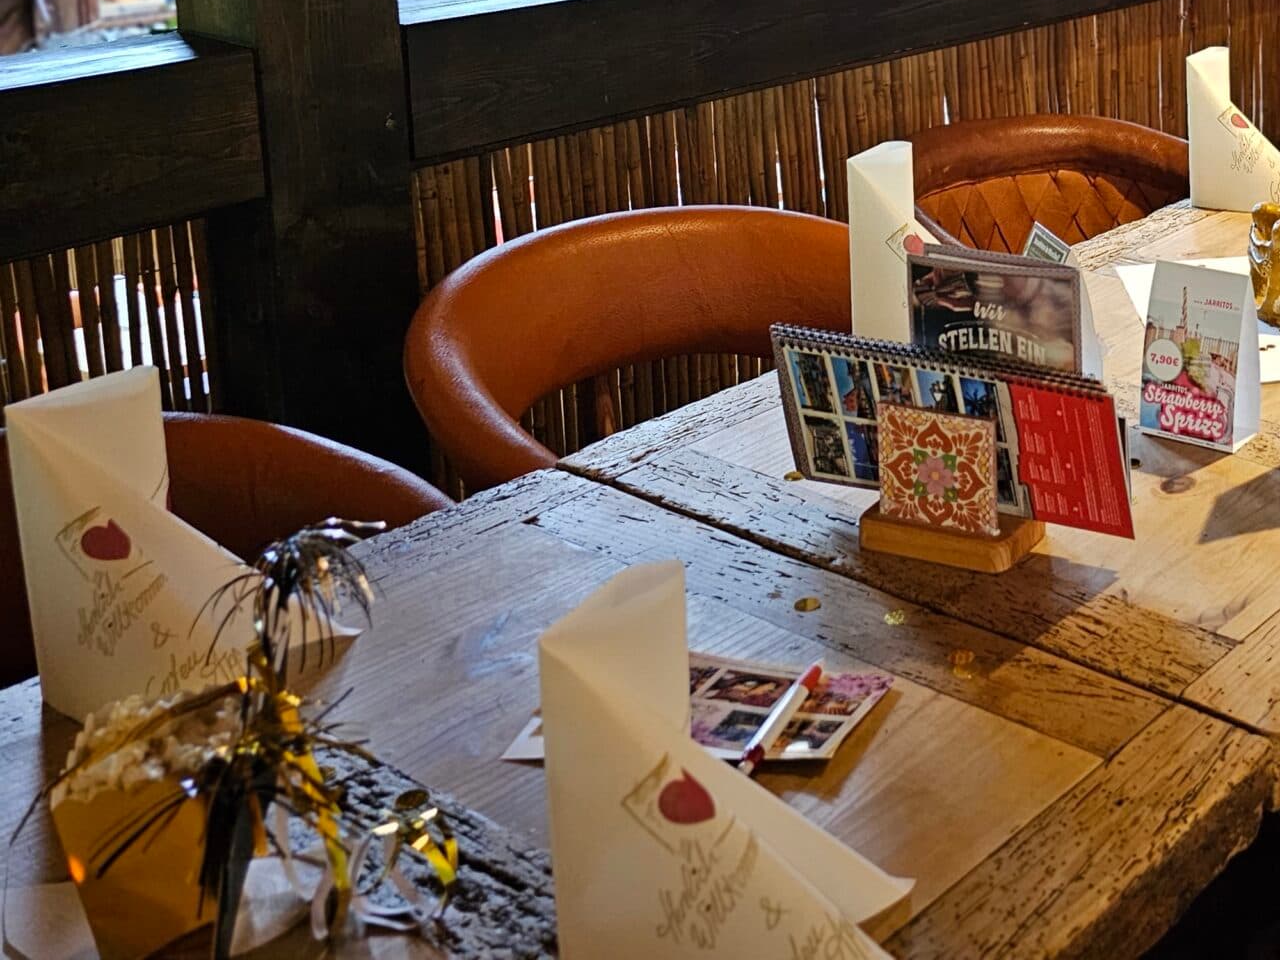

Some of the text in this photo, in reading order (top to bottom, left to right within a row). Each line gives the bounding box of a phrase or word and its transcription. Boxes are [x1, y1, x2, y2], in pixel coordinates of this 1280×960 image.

[973, 301, 1007, 321] Wir
[938, 327, 1046, 365] STELLEN EIN
[1150, 352, 1180, 367] 7,90€
[1145, 384, 1223, 419] Strawberry
[1161, 404, 1222, 437] Sprizz
